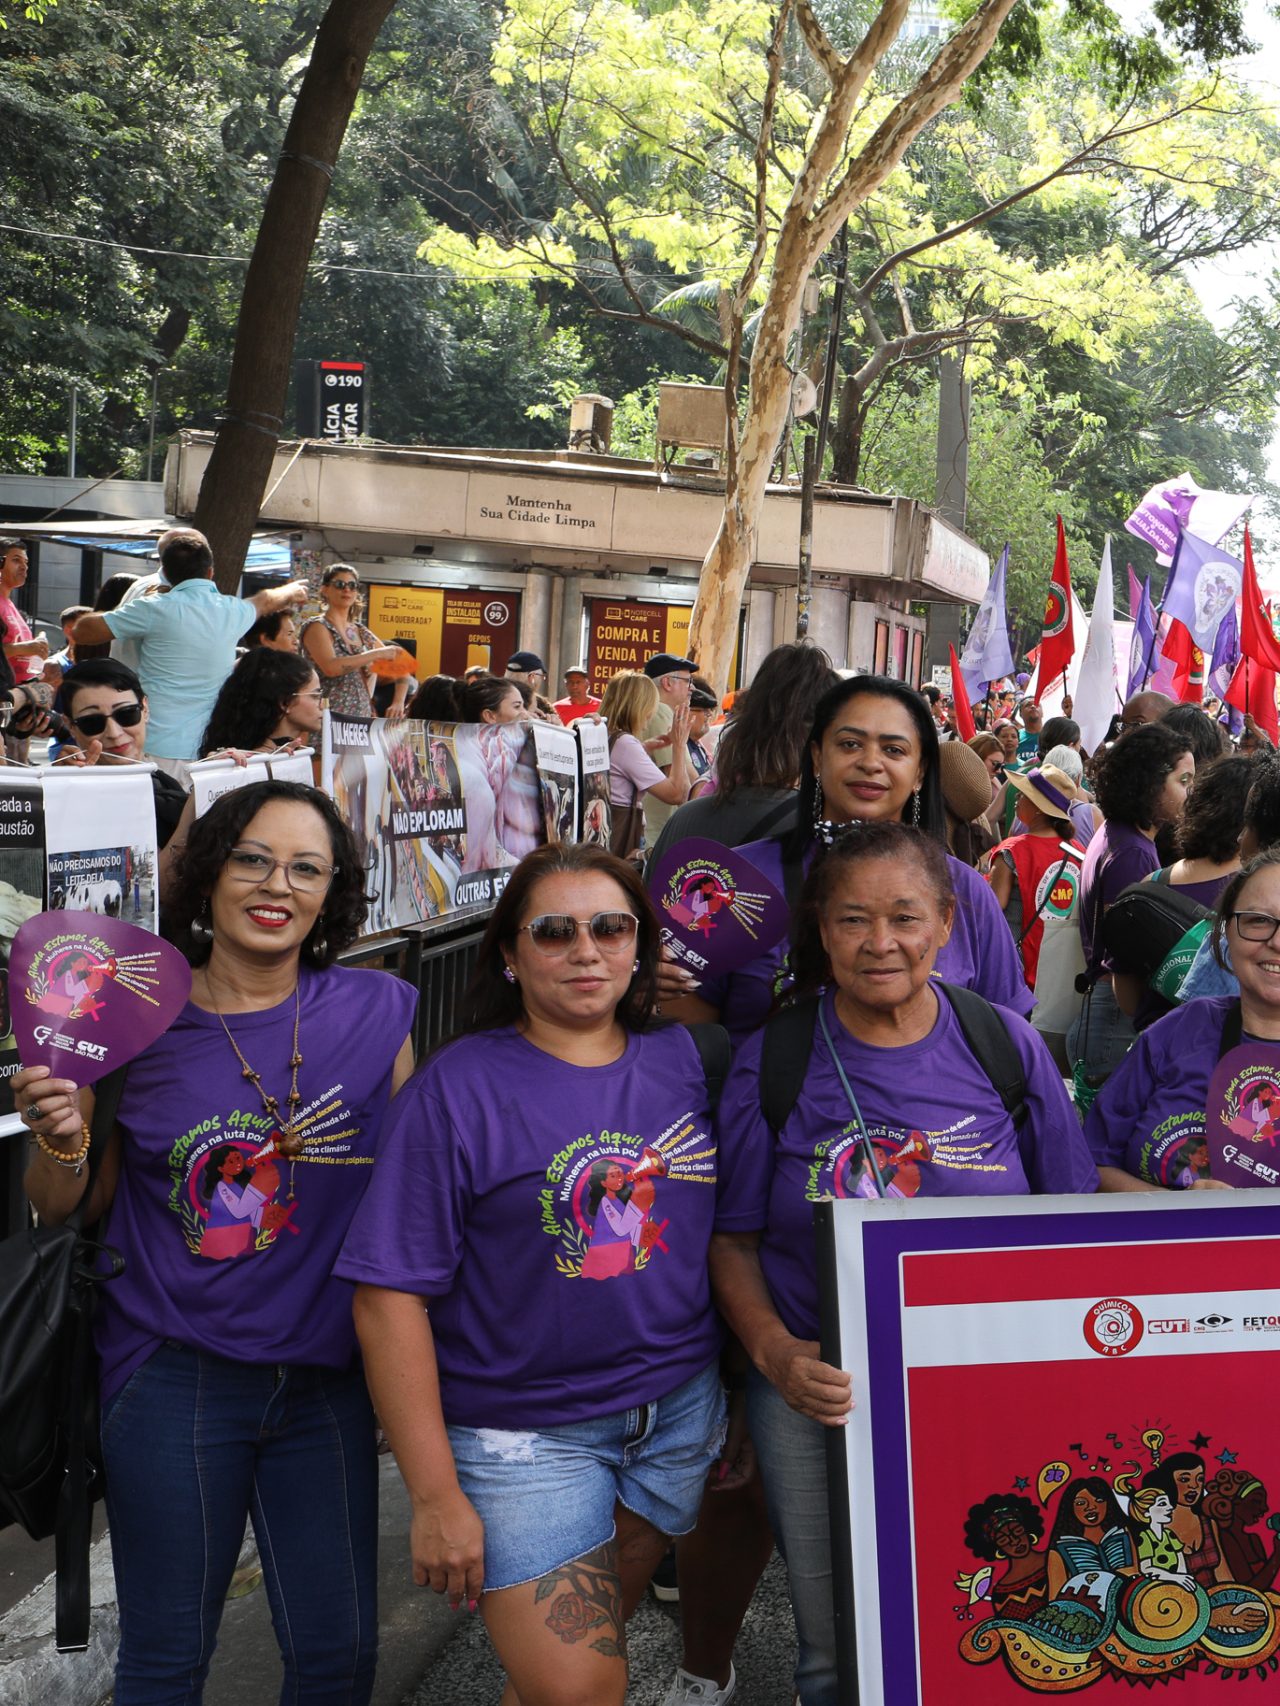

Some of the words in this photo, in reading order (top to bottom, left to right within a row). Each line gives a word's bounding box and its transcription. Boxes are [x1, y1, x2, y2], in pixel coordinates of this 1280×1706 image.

[338, 375, 362, 387] 190
[323, 403, 340, 442] LÍCIA
[506, 494, 572, 511] Mantenha
[480, 507, 503, 520] Sua
[508, 509, 550, 524] Cidade
[555, 514, 596, 528] Limpa
[1141, 508, 1177, 544] UTONOMIA
[446, 608, 481, 618] INSTALADA
[394, 630, 416, 638] ANTES
[468, 634, 491, 643] DEPOIS
[597, 625, 648, 643] COMPRA
[653, 629, 660, 643] E
[596, 645, 637, 662] VENDA
[0, 796, 22, 813] ada
[24, 800, 32, 813] a
[392, 808, 409, 835] NÃO
[409, 808, 464, 833] EXPLORAM
[50, 858, 63, 873] NÃO
[64, 857, 110, 871] PRECISAMOS
[111, 856, 121, 868] DO
[66, 874, 84, 887] LEITE
[85, 872, 105, 886] DELA
[456, 879, 491, 905] OUTRAS
[1050, 888, 1073, 900] CMP
[44, 933, 87, 951] Estamos
[45, 944, 72, 964] Mulheres
[686, 949, 709, 967] CUT
[1157, 955, 1192, 981] NACIONAL
[1224, 1078, 1240, 1102] Ainda
[1239, 1065, 1274, 1080] Estamos
[1239, 1075, 1262, 1090] Mulheres
[320, 1083, 343, 1103] direitos
[315, 1099, 343, 1119] decente
[311, 1116, 340, 1135] jornada
[956, 1114, 977, 1129] direitos
[1152, 1110, 1207, 1141] Estamos
[168, 1115, 221, 1168] Estamos
[208, 1134, 222, 1146] na
[224, 1131, 246, 1141] luta
[246, 1132, 265, 1143] por
[598, 1130, 644, 1149] Aqui!
[650, 1126, 674, 1150] Igualdade
[658, 1133, 682, 1154] Trabalho
[928, 1137, 942, 1145] Fim
[1154, 1126, 1190, 1159] Mulheres
[1190, 1124, 1203, 1134] na
[320, 1144, 351, 1154] climática
[661, 1150, 673, 1161] Fim
[825, 1136, 854, 1172] Mulheres
[887, 1130, 905, 1142] por
[933, 1150, 957, 1162] Justiça
[936, 1144, 958, 1153] Justiça
[308, 1156, 335, 1164] anistia
[546, 1133, 596, 1184] Estamos
[671, 1153, 694, 1164] Justiça
[931, 1156, 948, 1168] Sem
[947, 1160, 972, 1170] anistia
[560, 1155, 589, 1202] Mulheres
[587, 1148, 601, 1160] na
[600, 1145, 620, 1155] luta
[621, 1147, 639, 1159] por
[667, 1171, 683, 1180] Sem
[669, 1163, 692, 1173] Justiça
[804, 1157, 824, 1200] Ainda
[537, 1189, 562, 1236] Ainda
[1093, 1300, 1132, 1316] QUÍMICOS
[1148, 1320, 1186, 1333] CUT
